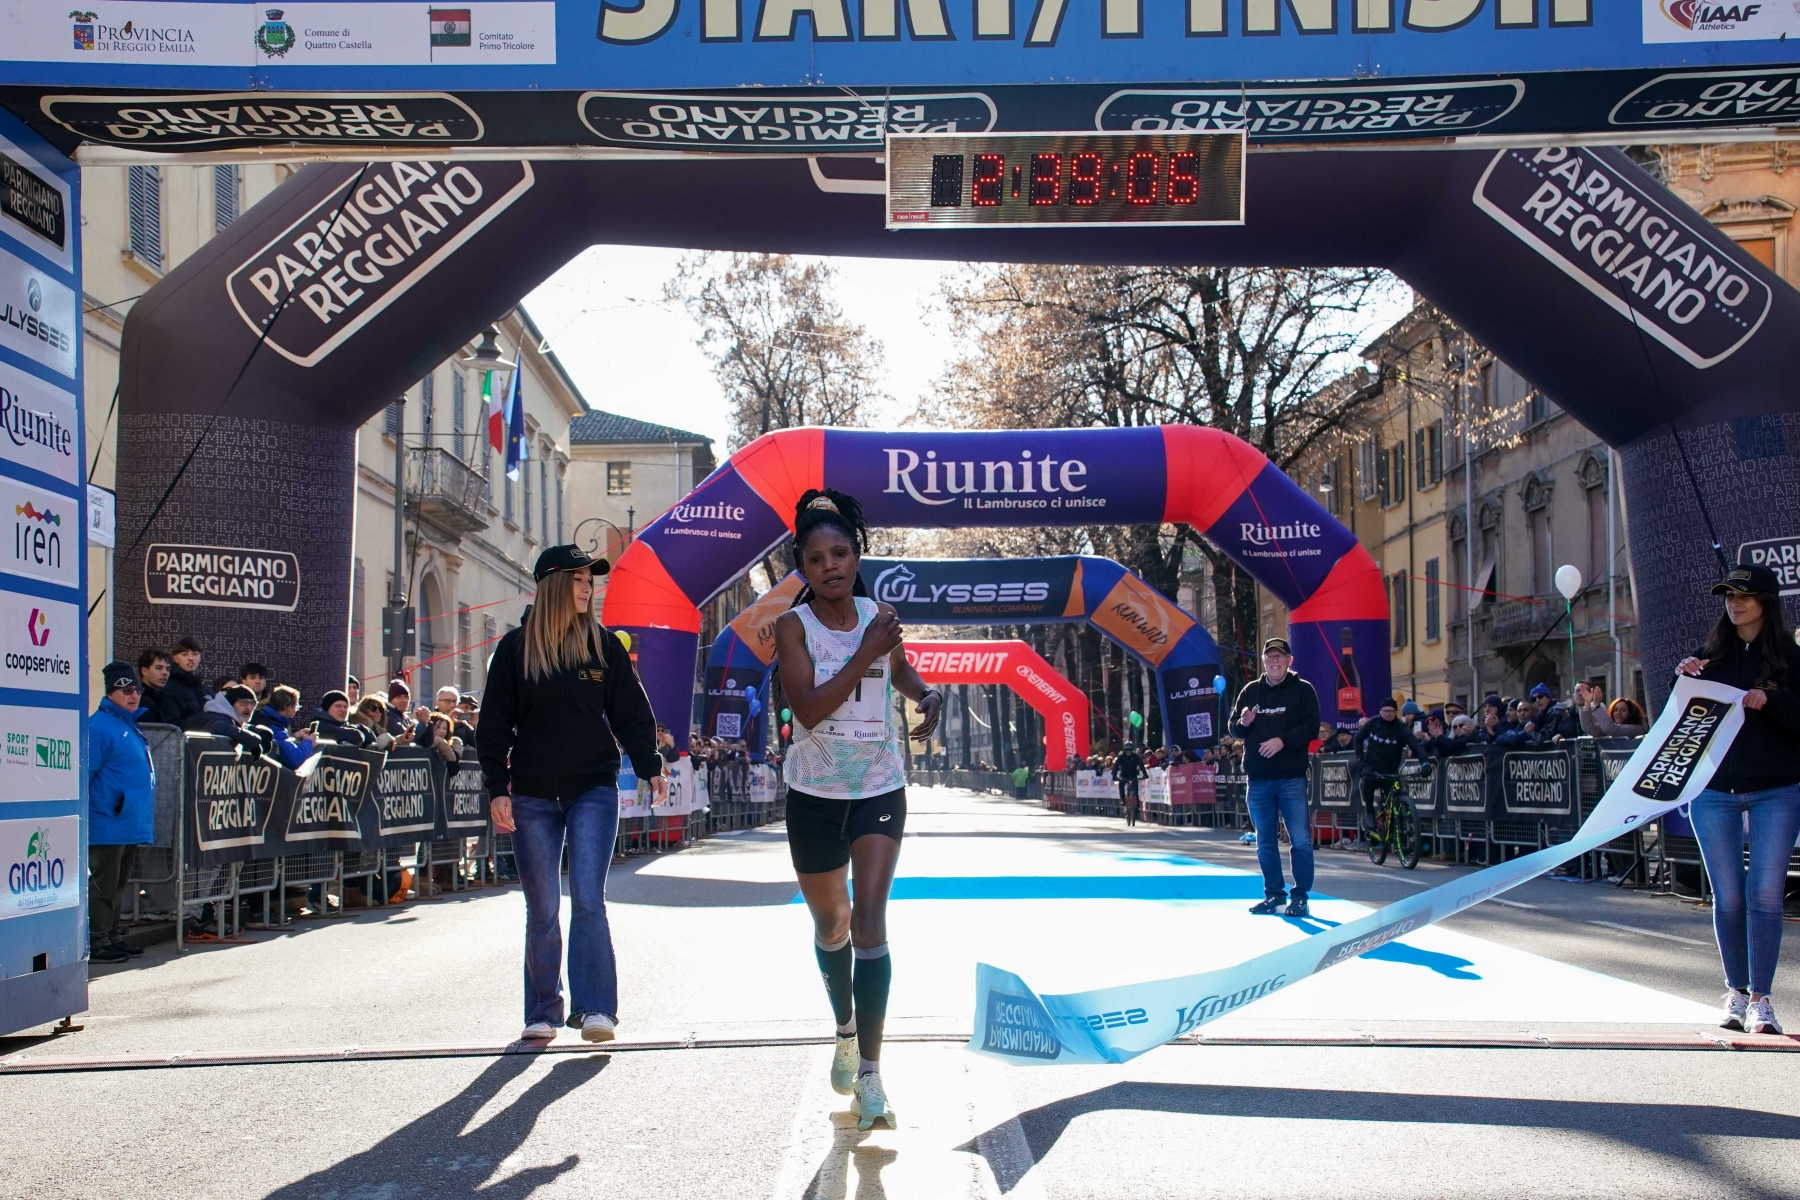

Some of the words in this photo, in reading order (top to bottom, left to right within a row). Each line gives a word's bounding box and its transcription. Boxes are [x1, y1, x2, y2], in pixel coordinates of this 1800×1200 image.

[1700, 4, 1762, 22] IAAF
[97, 24, 195, 42] PROVINCIA
[304, 28, 338, 38] Comune
[342, 28, 350, 37] di
[479, 32, 514, 41] Comitato
[98, 41, 109, 50] DI
[113, 41, 157, 52] REGGIO
[159, 42, 196, 52] EMILIA
[304, 40, 337, 50] Quattro
[339, 40, 373, 49] Castella
[479, 42, 502, 50] Primo
[503, 42, 535, 50] Tricolore
[117, 105, 406, 124] REGGIANO
[648, 105, 925, 124] REGGIANO
[1171, 94, 1455, 118] REGGIANO
[106, 123, 452, 140] PARMIGIANO
[4, 160, 60, 216] PARMIGIANO
[972, 152, 1200, 206] 2:39:06
[10, 190, 56, 235] REGGIANO
[249, 161, 450, 306] PARMIGIA
[300, 166, 483, 323] REGGIANO
[1522, 180, 1706, 324] REGGIANO
[0, 386, 72, 456] Riunite
[883, 448, 1087, 505] Riunite
[668, 502, 745, 522] Riunite
[964, 498, 973, 508] Il
[976, 498, 1047, 508] Lambrusco
[1050, 496, 1062, 508] ci
[1066, 496, 1106, 507] unisce
[670, 528, 709, 536] Lambrusco
[718, 531, 742, 539] unisce
[1240, 520, 1321, 546] Riunite
[1248, 550, 1288, 558] Lambrusco
[1298, 548, 1322, 556] unisce
[156, 552, 287, 579] PARMIGIANO
[167, 574, 275, 599] REGGIANO
[882, 582, 1050, 603] ULYSSES
[952, 604, 996, 614] RUNNING
[998, 604, 1044, 613] COMPANY
[1111, 603, 1142, 624] RUN
[6, 652, 70, 676] coopservice
[916, 652, 1009, 673] ENERVIT
[708, 688, 747, 697] ULYSSE
[1027, 673, 1067, 704] ENERVIT
[7, 732, 29, 744] SPORT
[1640, 705, 1709, 790] PARMIGIANO
[6, 745, 29, 756] VALLEY
[48, 738, 72, 770] RER
[1662, 715, 1718, 786] REGGIANO
[1508, 759, 1566, 780] PARMIGIANO
[1517, 782, 1562, 802] REGGIANO
[8, 858, 64, 895] GIGLIO
